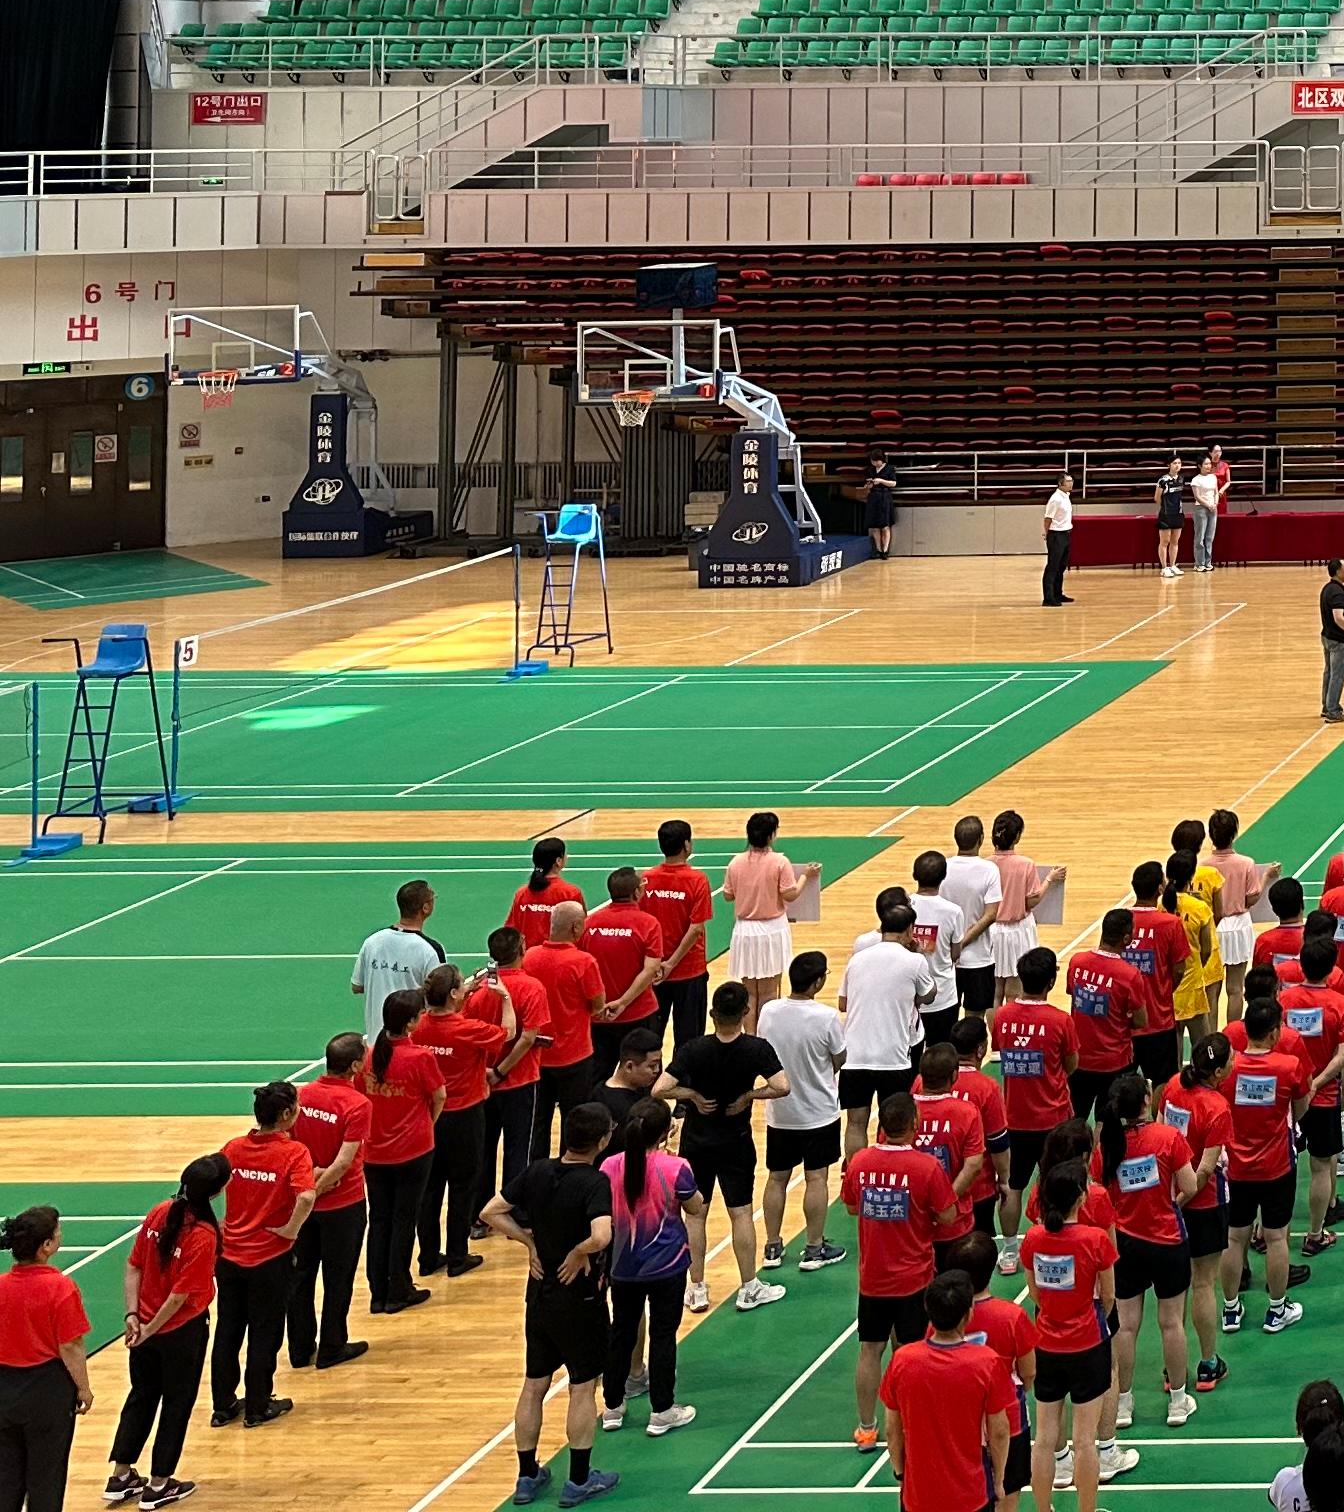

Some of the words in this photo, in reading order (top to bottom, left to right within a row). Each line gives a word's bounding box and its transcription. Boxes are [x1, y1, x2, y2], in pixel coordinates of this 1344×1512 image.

[195, 95, 261, 107] 12号门出口
[84, 280, 176, 304] 6号门
[131, 377, 148, 397] 6
[702, 385, 711, 397] 1
[182, 640, 194, 662] 5
[597, 927, 633, 937] VICTOR
[1074, 968, 1113, 988] CHINA
[1001, 1022, 1045, 1036] CHINA
[238, 1168, 277, 1182] VICTOR
[859, 1171, 909, 1187] CHINA
